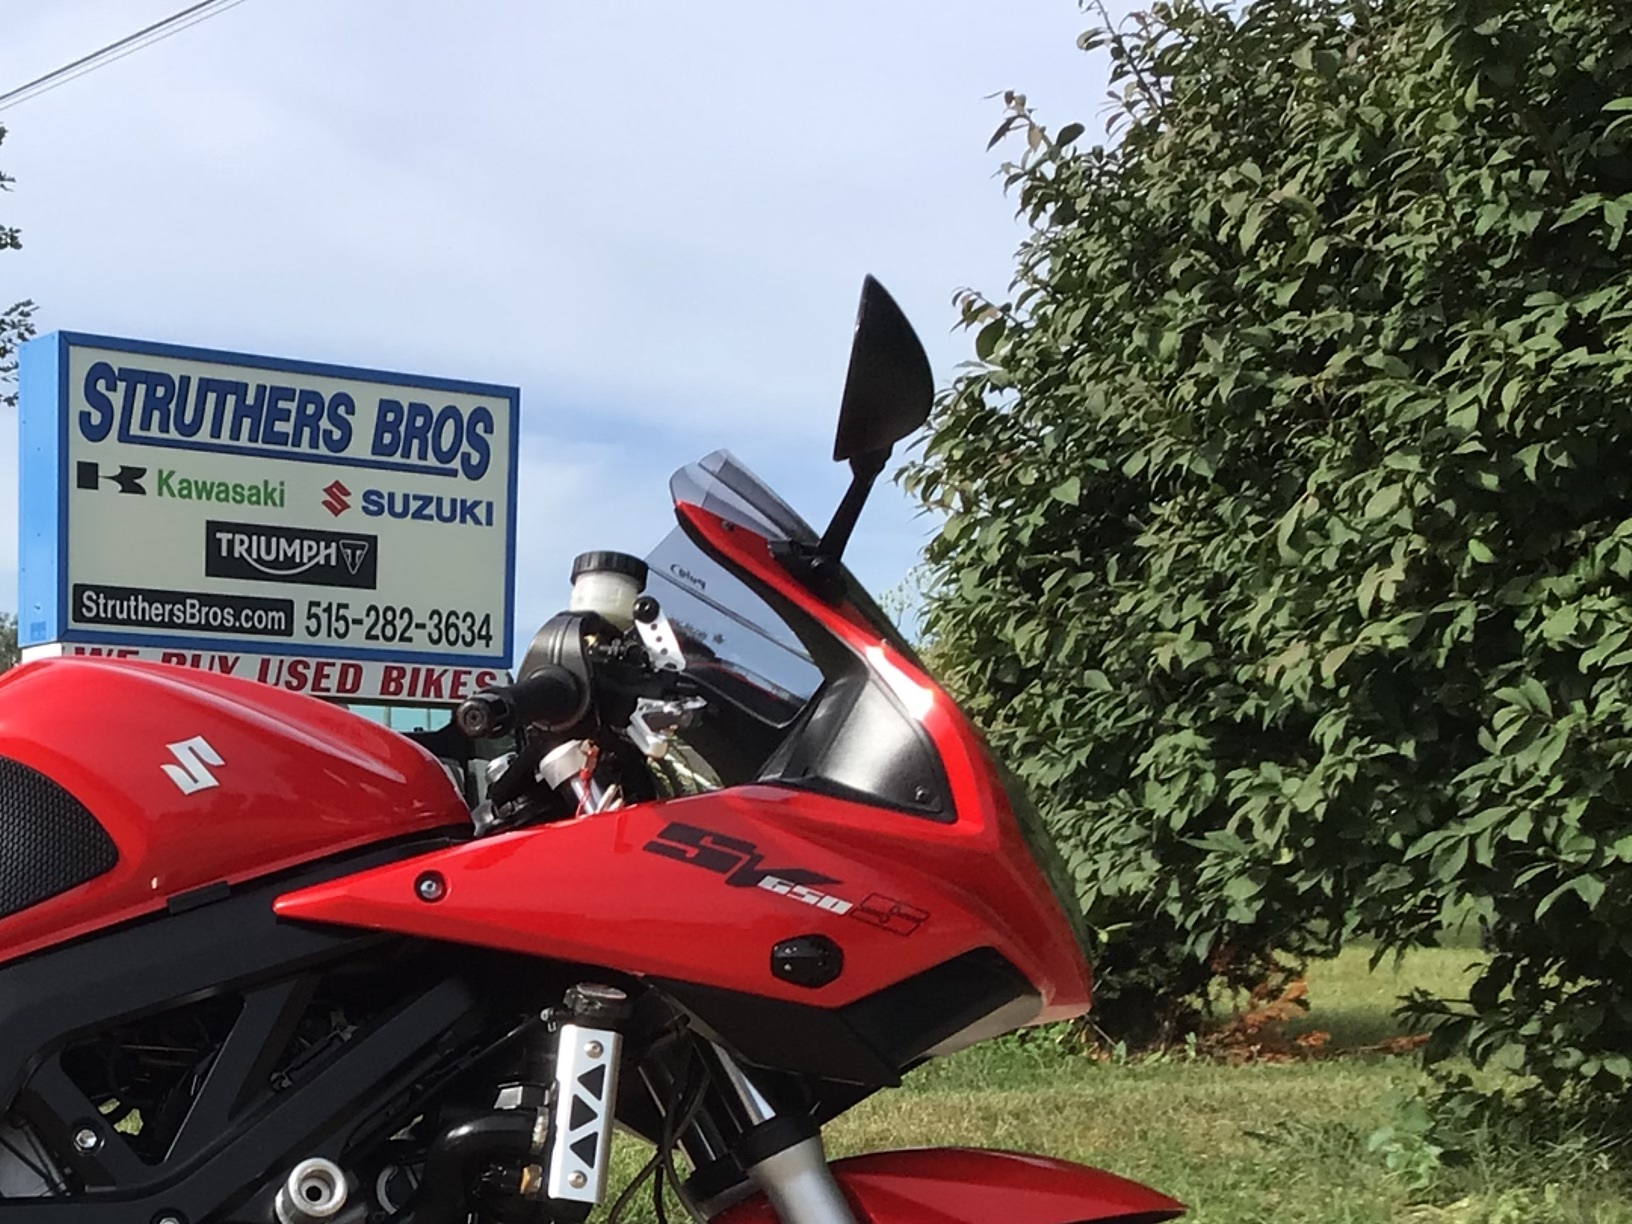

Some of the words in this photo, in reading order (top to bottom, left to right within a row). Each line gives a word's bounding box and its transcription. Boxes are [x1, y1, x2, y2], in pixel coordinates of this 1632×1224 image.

[78, 361, 356, 454] STRUTHERS
[371, 398, 495, 481] BROS
[156, 468, 286, 508] Kawasaki
[361, 489, 494, 527] SUZUKI
[215, 531, 338, 574] TRIUMPH
[81, 590, 286, 631] StruthersBros.com
[305, 600, 493, 649] 515-282-3634
[256, 658, 364, 694] USED
[379, 665, 497, 700] BIKES
[757, 875, 854, 916] 650
